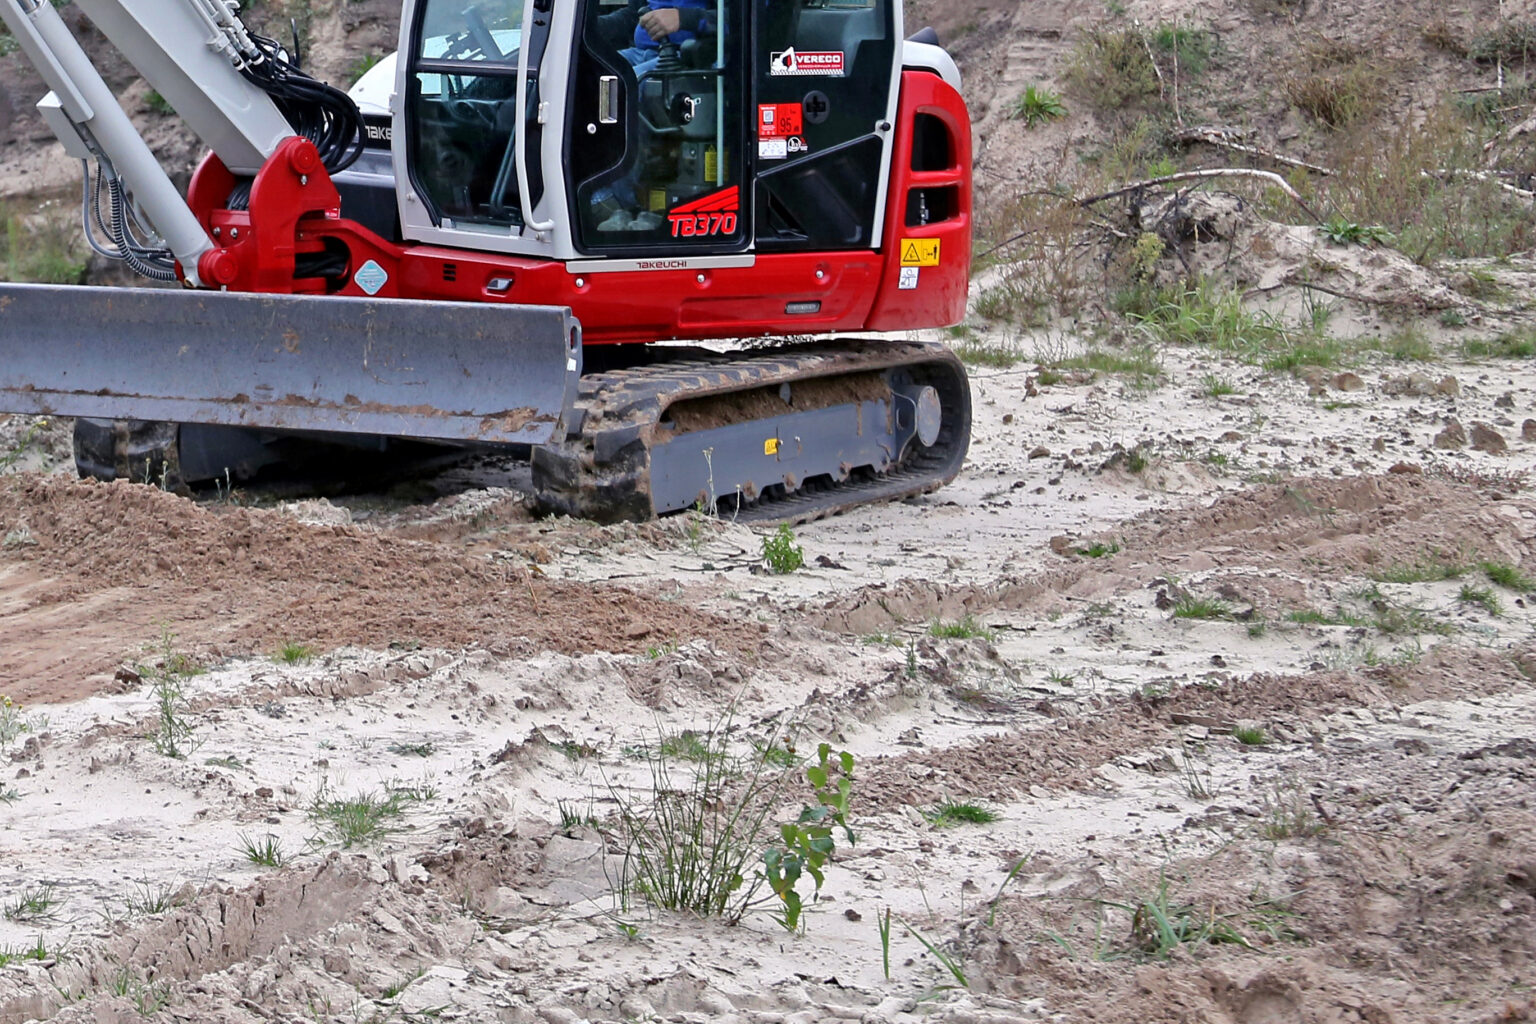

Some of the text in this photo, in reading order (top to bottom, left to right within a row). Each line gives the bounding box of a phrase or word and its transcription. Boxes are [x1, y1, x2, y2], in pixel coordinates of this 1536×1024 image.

[796, 55, 841, 64] VERECO
[779, 117, 792, 133] 95
[667, 212, 737, 237] TB370
[636, 260, 687, 269] TAKEUCHI
